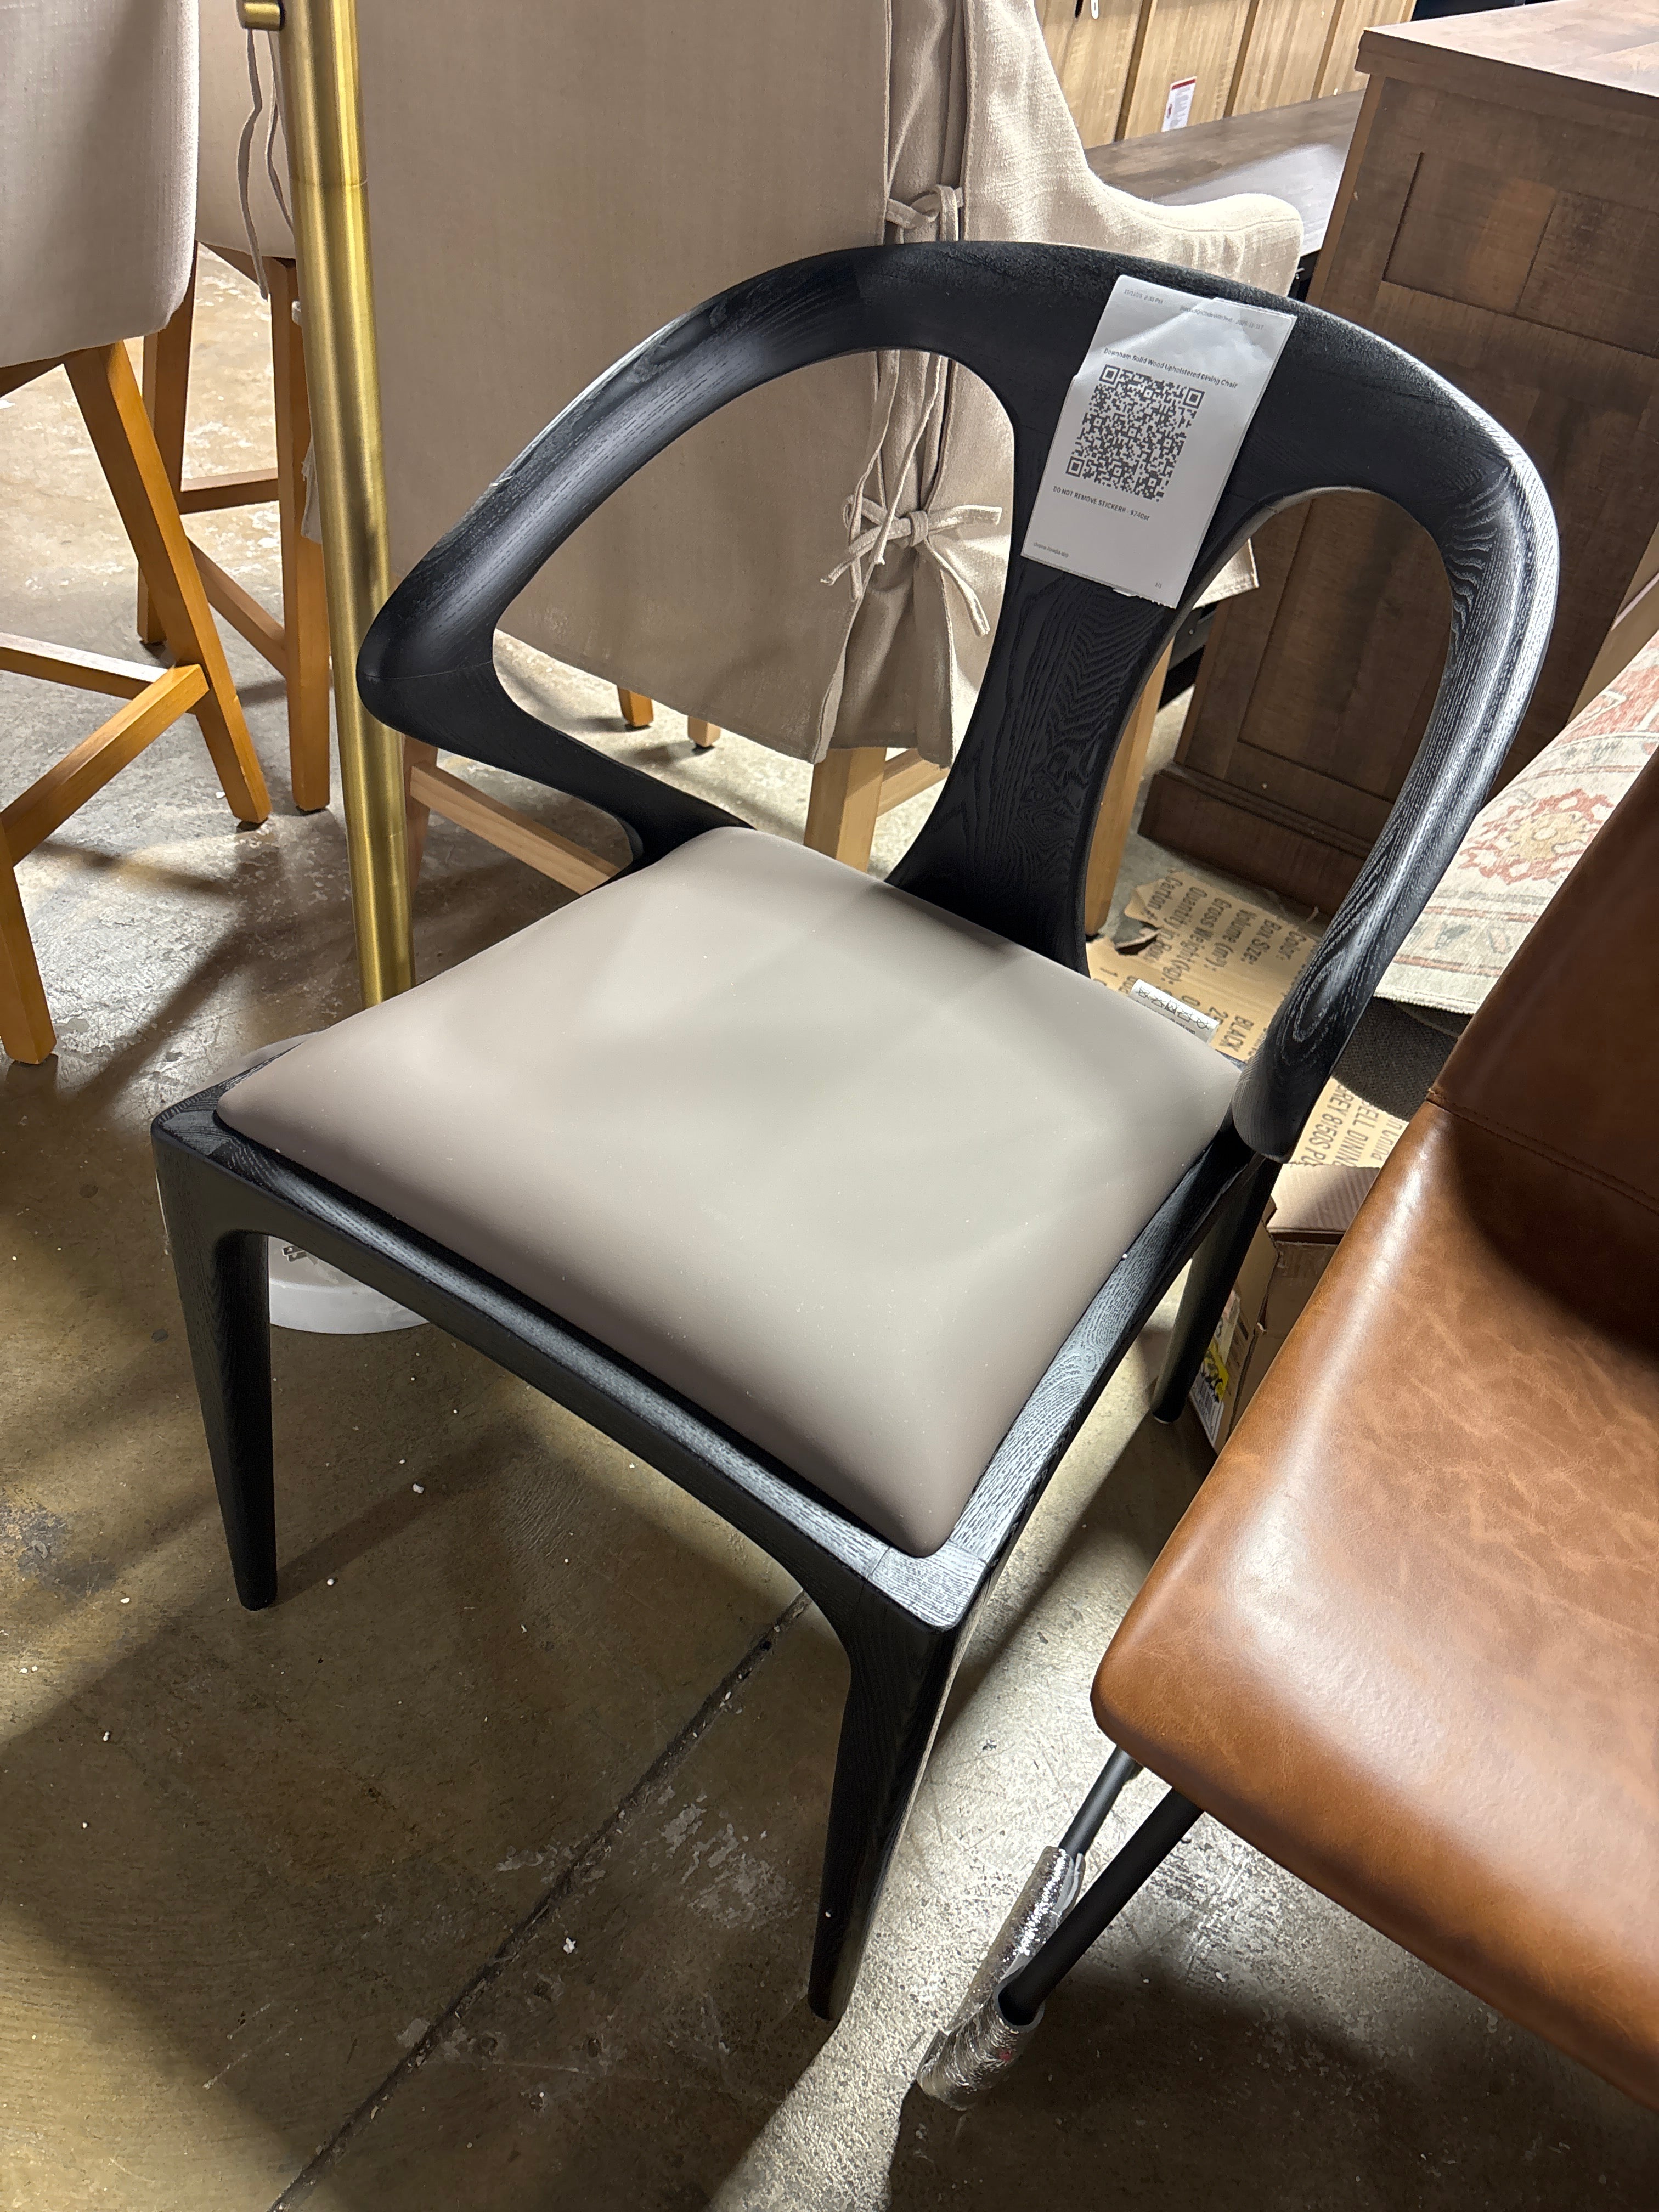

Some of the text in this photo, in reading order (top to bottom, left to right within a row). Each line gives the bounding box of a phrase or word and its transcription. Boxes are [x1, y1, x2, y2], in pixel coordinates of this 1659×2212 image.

[1104, 348, 1238, 389] Downham Solid Wood Upholstered Dining Chair
[1062, 488, 1074, 497] NOT
[1074, 492, 1097, 505] REMOVE
[1098, 500, 1126, 514] STICKER!!
[1147, 876, 1183, 911] Carton
[1163, 887, 1207, 929] Quantity
[1200, 897, 1232, 928] Gross
[1222, 909, 1257, 943] Volume
[1176, 926, 1214, 962] Weight
[1241, 919, 1282, 965] Box Size:
[1276, 930, 1306, 961] Color:
[1218, 1015, 1255, 1052] BLACK
[1352, 1102, 1379, 1129] ELL
